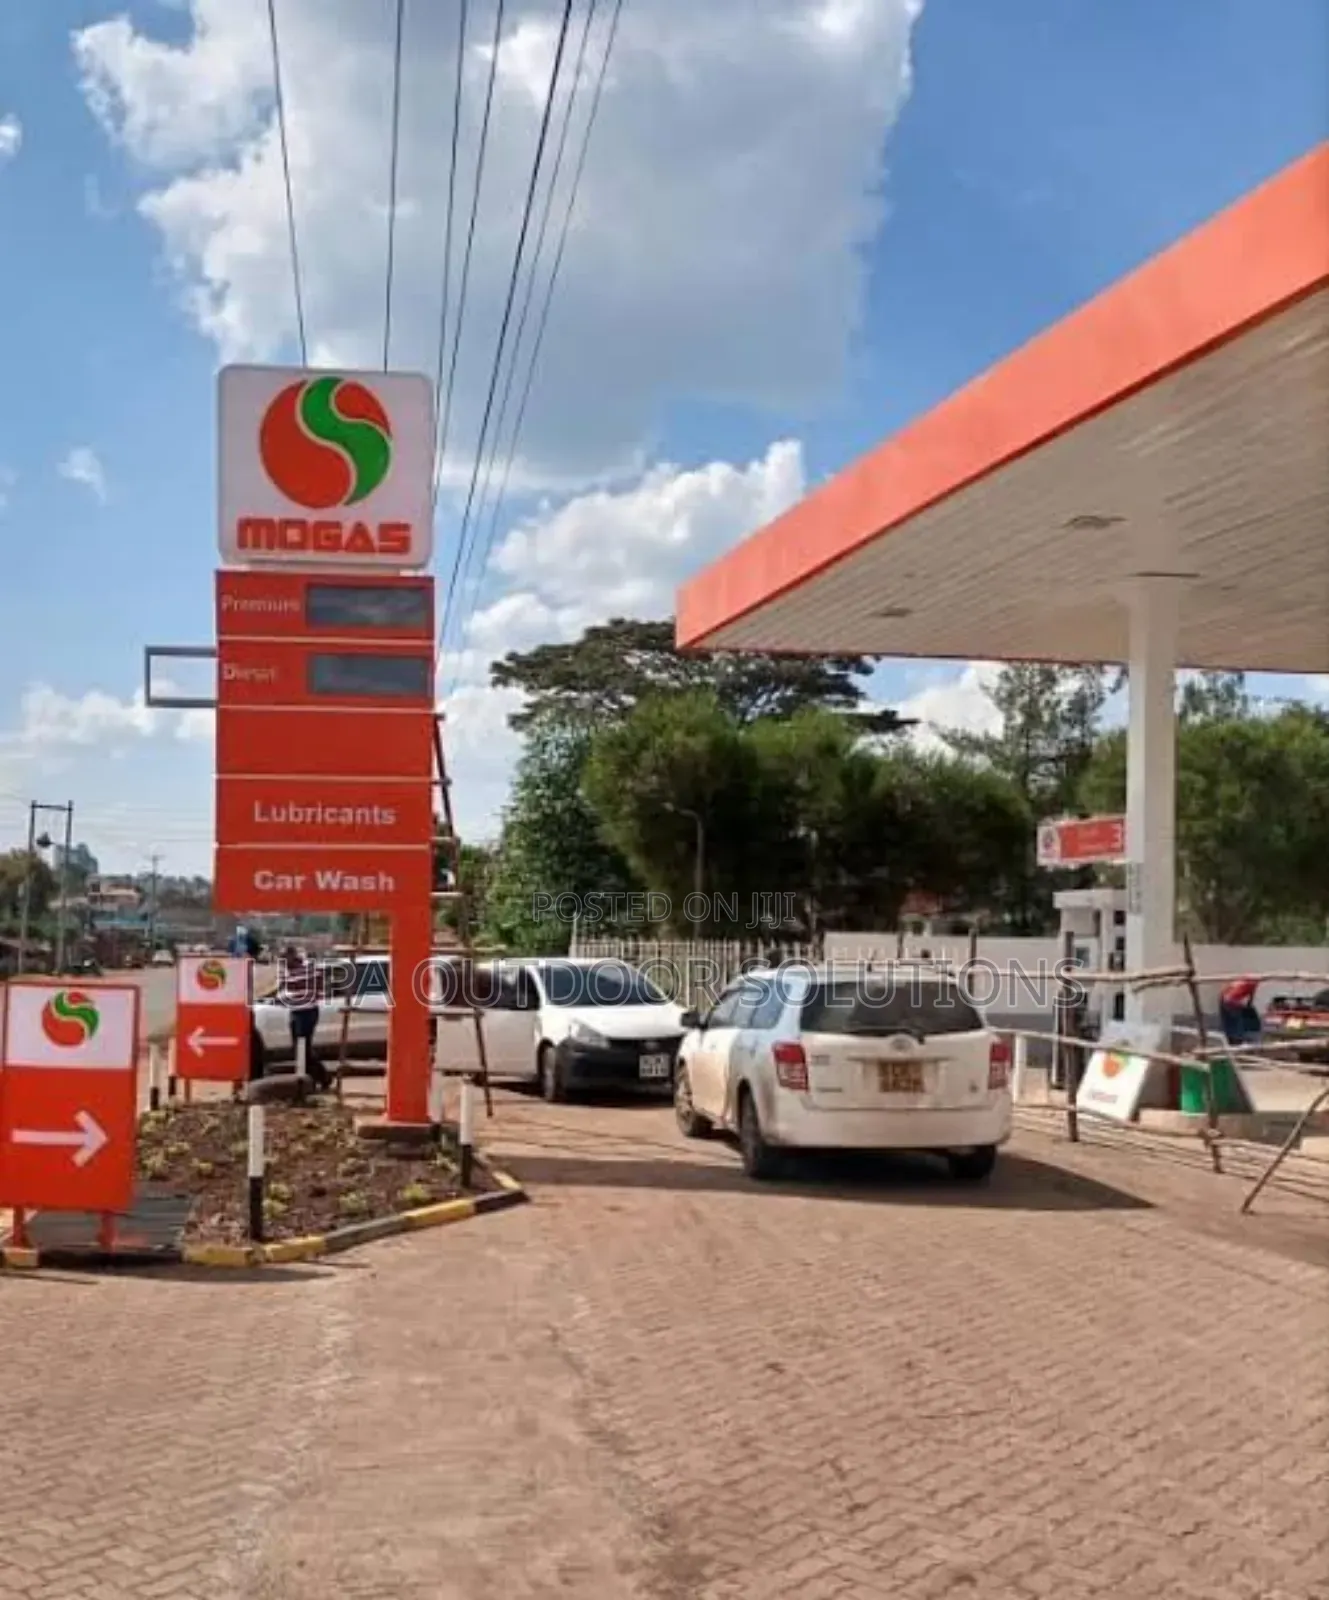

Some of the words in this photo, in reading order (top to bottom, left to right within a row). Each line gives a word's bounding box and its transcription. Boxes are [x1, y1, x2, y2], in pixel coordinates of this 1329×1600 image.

[237, 518, 412, 555] MOGAS
[253, 800, 396, 826] Lubricants
[253, 869, 306, 891] Car
[315, 870, 395, 892] Wash
